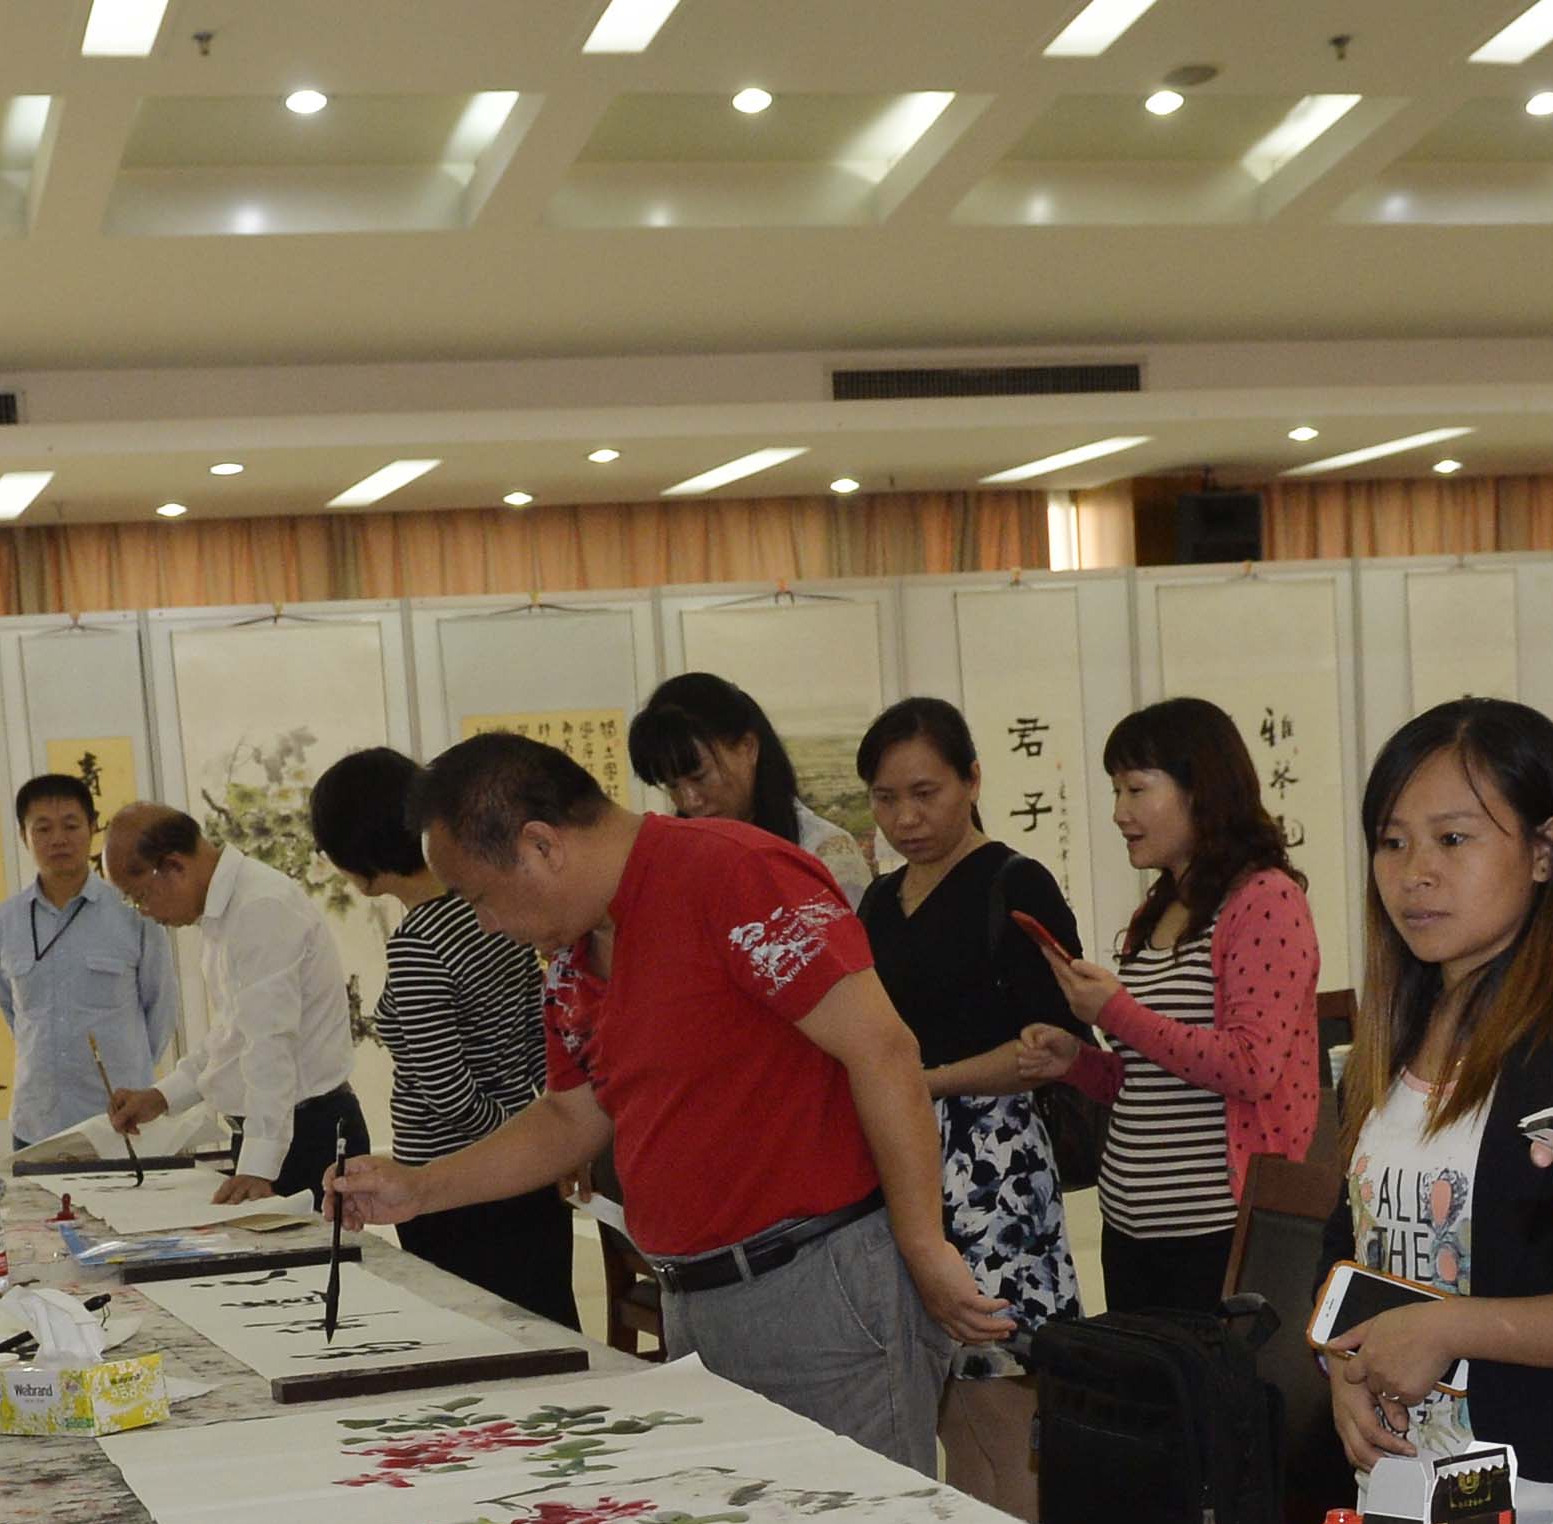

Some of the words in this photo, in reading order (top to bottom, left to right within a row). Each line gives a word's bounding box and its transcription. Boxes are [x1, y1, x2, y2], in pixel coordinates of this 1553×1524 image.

[1008, 718, 1052, 832] 君子
[1376, 1167, 1431, 1225] ALL
[1372, 1227, 1432, 1281] THE
